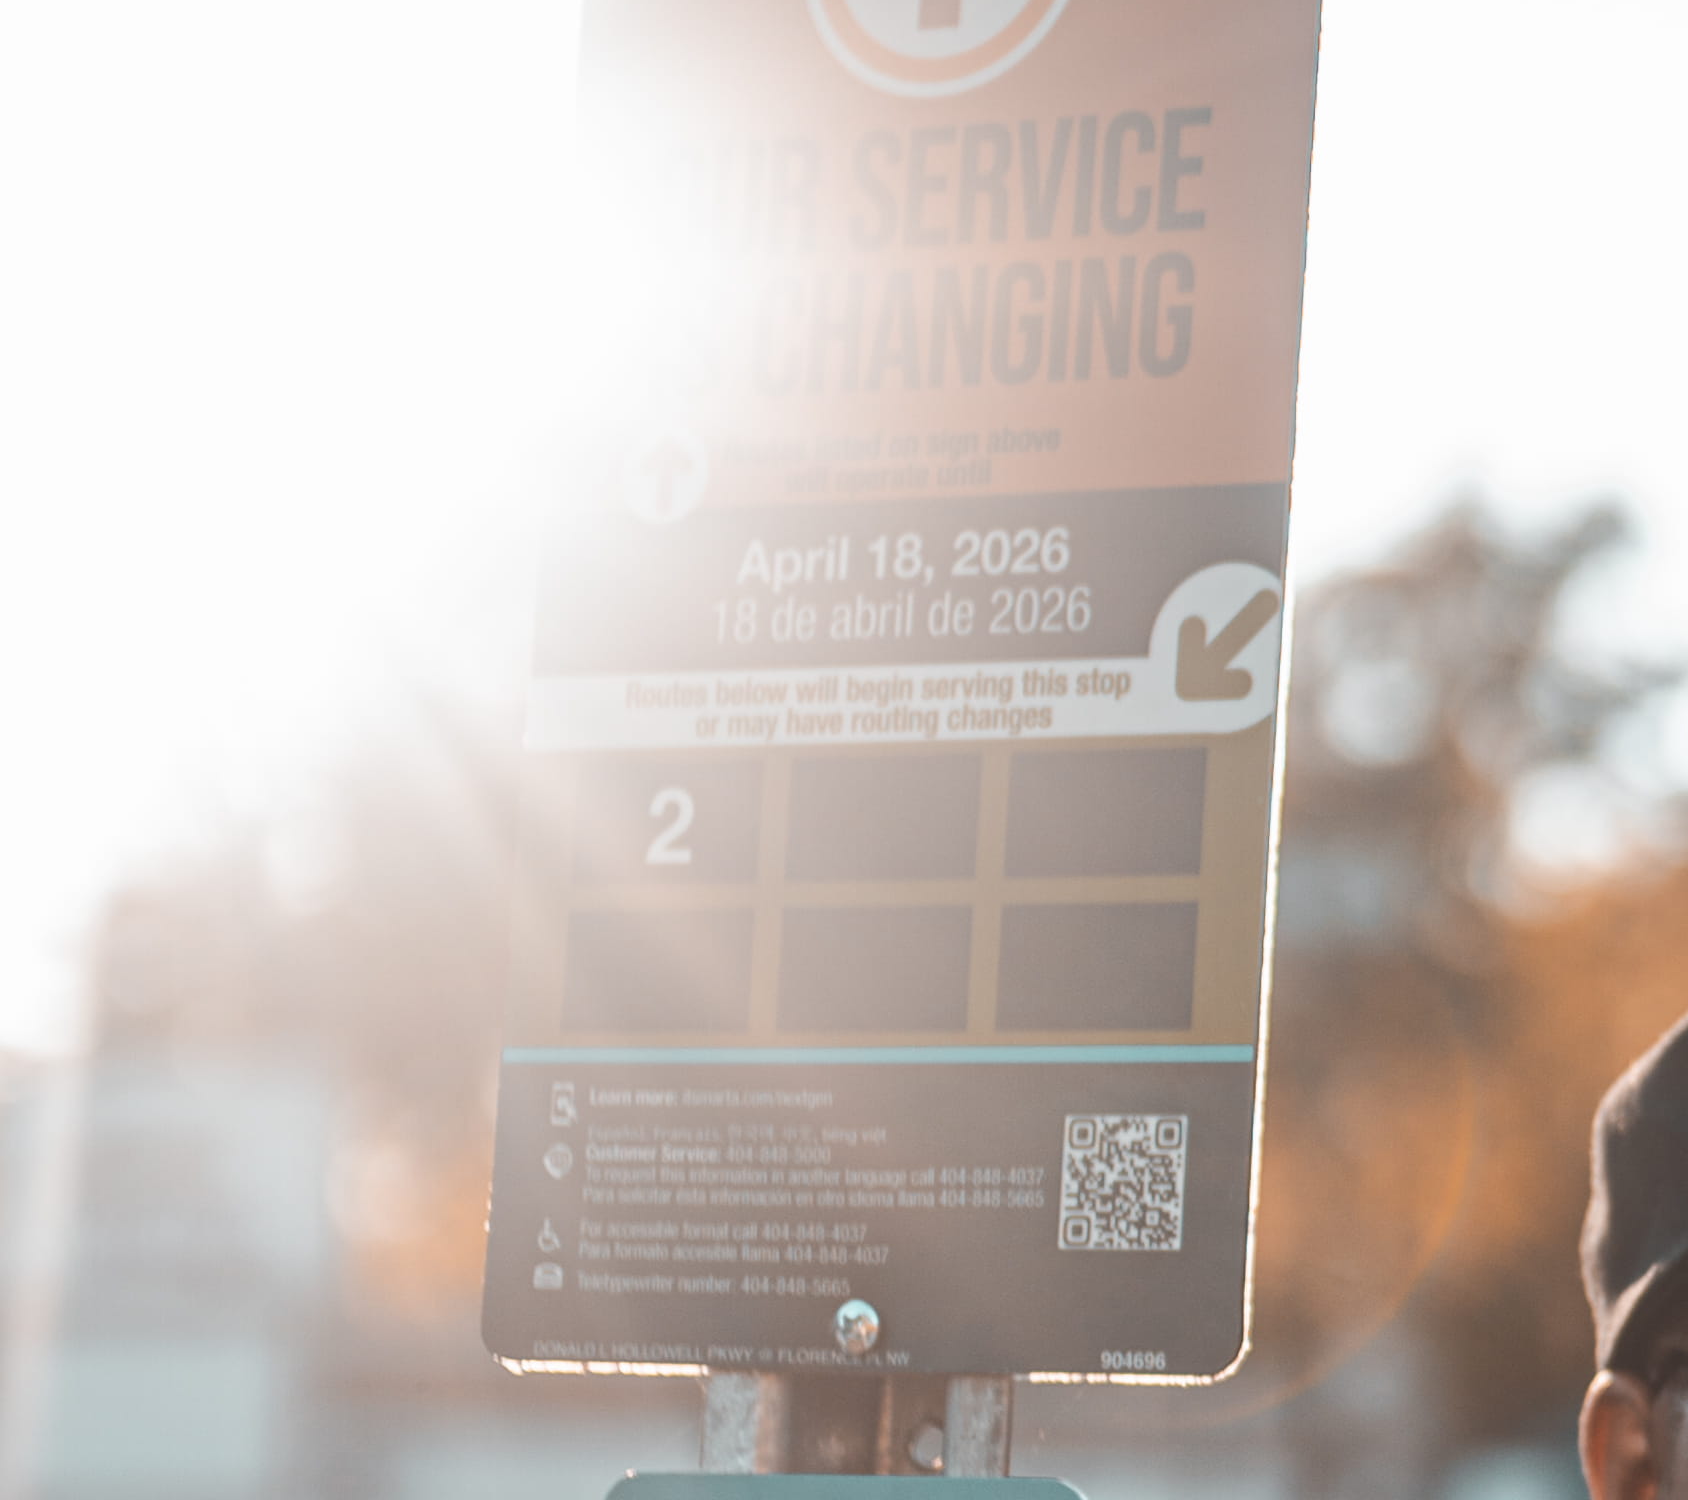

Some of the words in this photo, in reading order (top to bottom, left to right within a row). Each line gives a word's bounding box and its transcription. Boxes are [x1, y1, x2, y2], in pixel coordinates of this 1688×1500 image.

[848, 106, 1214, 253] SERVICE
[754, 249, 1196, 399] CHANGING
[888, 434, 920, 457] on
[925, 428, 979, 461] sign
[987, 423, 1062, 453] above
[836, 466, 928, 498] operate
[936, 460, 993, 486] until
[737, 535, 853, 592] April
[868, 533, 935, 586] 18,
[951, 526, 1071, 577] 2026
[714, 598, 757, 645] 18
[771, 596, 817, 642] de
[831, 591, 915, 641] abril
[927, 589, 975, 637] de
[988, 586, 1092, 635] 2026
[624, 679, 707, 708] Routes
[715, 677, 789, 707] below
[795, 675, 839, 704] will
[845, 671, 913, 708] begin
[919, 670, 1013, 707] serving
[1021, 668, 1068, 698] this
[1076, 666, 1131, 701] stop
[695, 713, 718, 738] or
[727, 713, 778, 742] may
[785, 707, 843, 736] have
[849, 704, 939, 740] routing
[946, 703, 1053, 736] changes
[645, 786, 696, 866] 2
[585, 1142, 656, 1163] Customer
[660, 1167, 685, 1184] this
[690, 1167, 769, 1185] information
[772, 1169, 784, 1184] in
[788, 1168, 840, 1185] another
[845, 1168, 907, 1189] language
[911, 1168, 935, 1186] call
[940, 1167, 1044, 1186] 404-848-4037
[582, 1187, 615, 1204] Para
[796, 1192, 815, 1206] en
[848, 1189, 894, 1207] idioma
[898, 1189, 934, 1208] llama
[580, 1220, 602, 1238] For
[732, 1222, 758, 1241] call
[762, 1222, 867, 1243] 404-848-4037
[580, 1242, 611, 1260] Para
[614, 1242, 669, 1260] formato
[741, 1243, 780, 1263] llama
[784, 1244, 889, 1267] 404-848-4037
[707, 1345, 753, 1362] PKWY
[886, 1349, 910, 1366] NW
[1100, 1349, 1167, 1371] 904696
